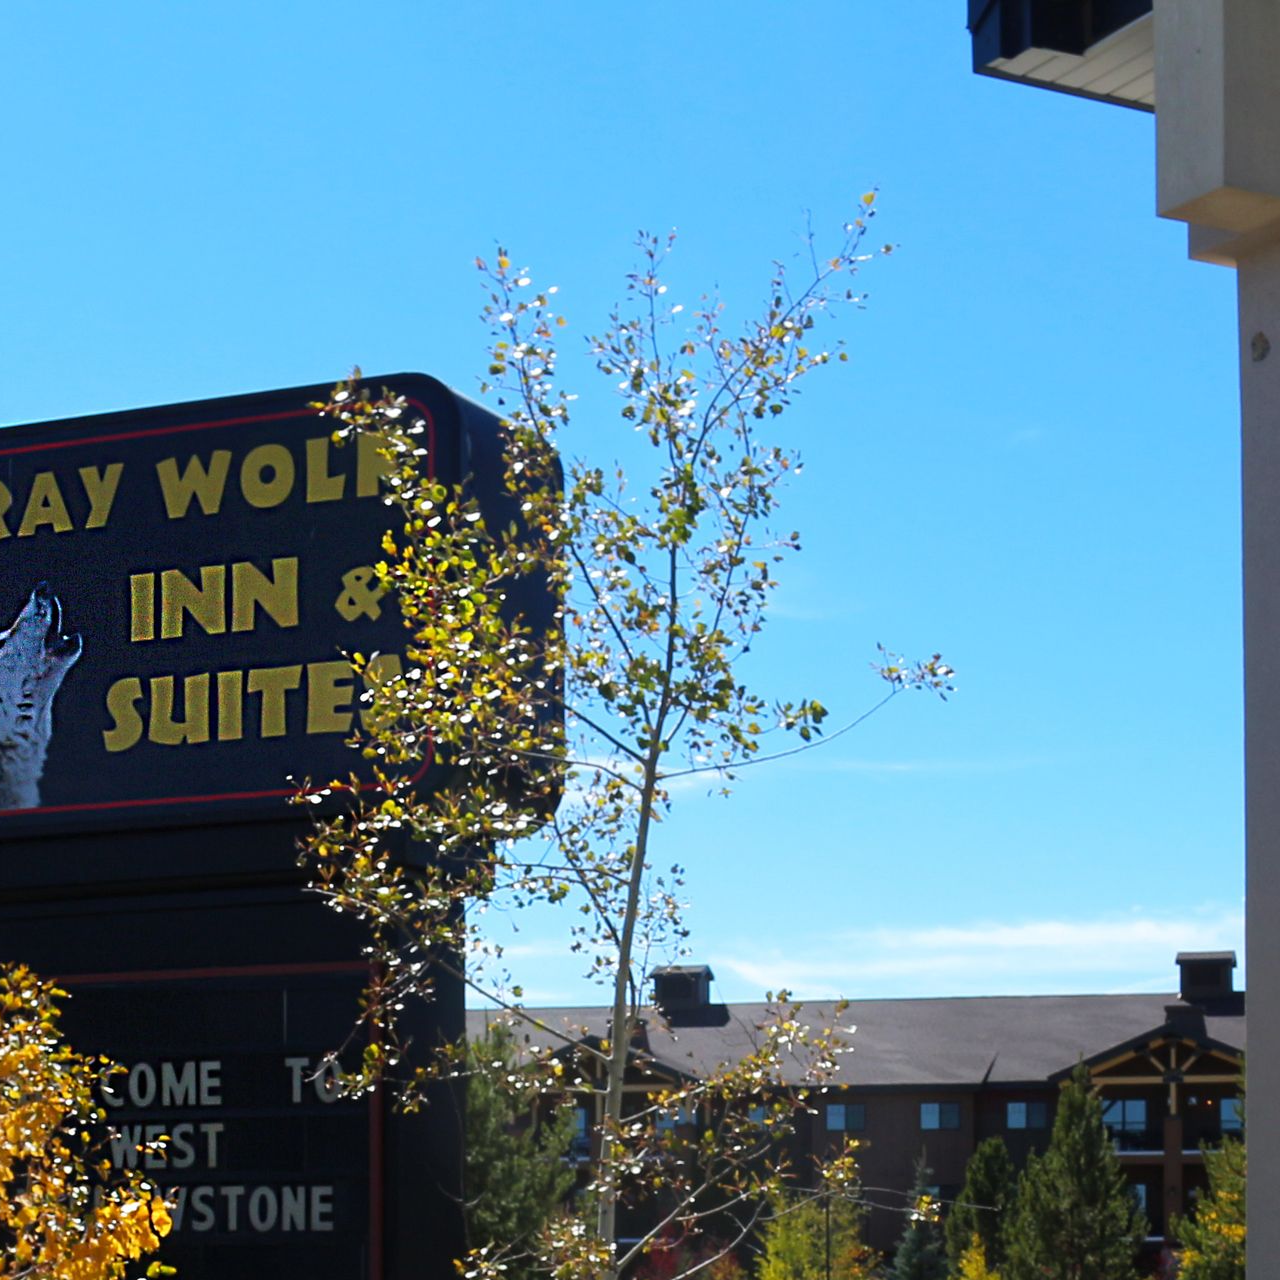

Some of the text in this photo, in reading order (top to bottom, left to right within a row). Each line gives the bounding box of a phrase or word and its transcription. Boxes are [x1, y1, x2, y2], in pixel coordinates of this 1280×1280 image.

[129, 556, 388, 642] INN &
[284, 1057, 346, 1104] TO
[107, 1122, 224, 1170] WEST
